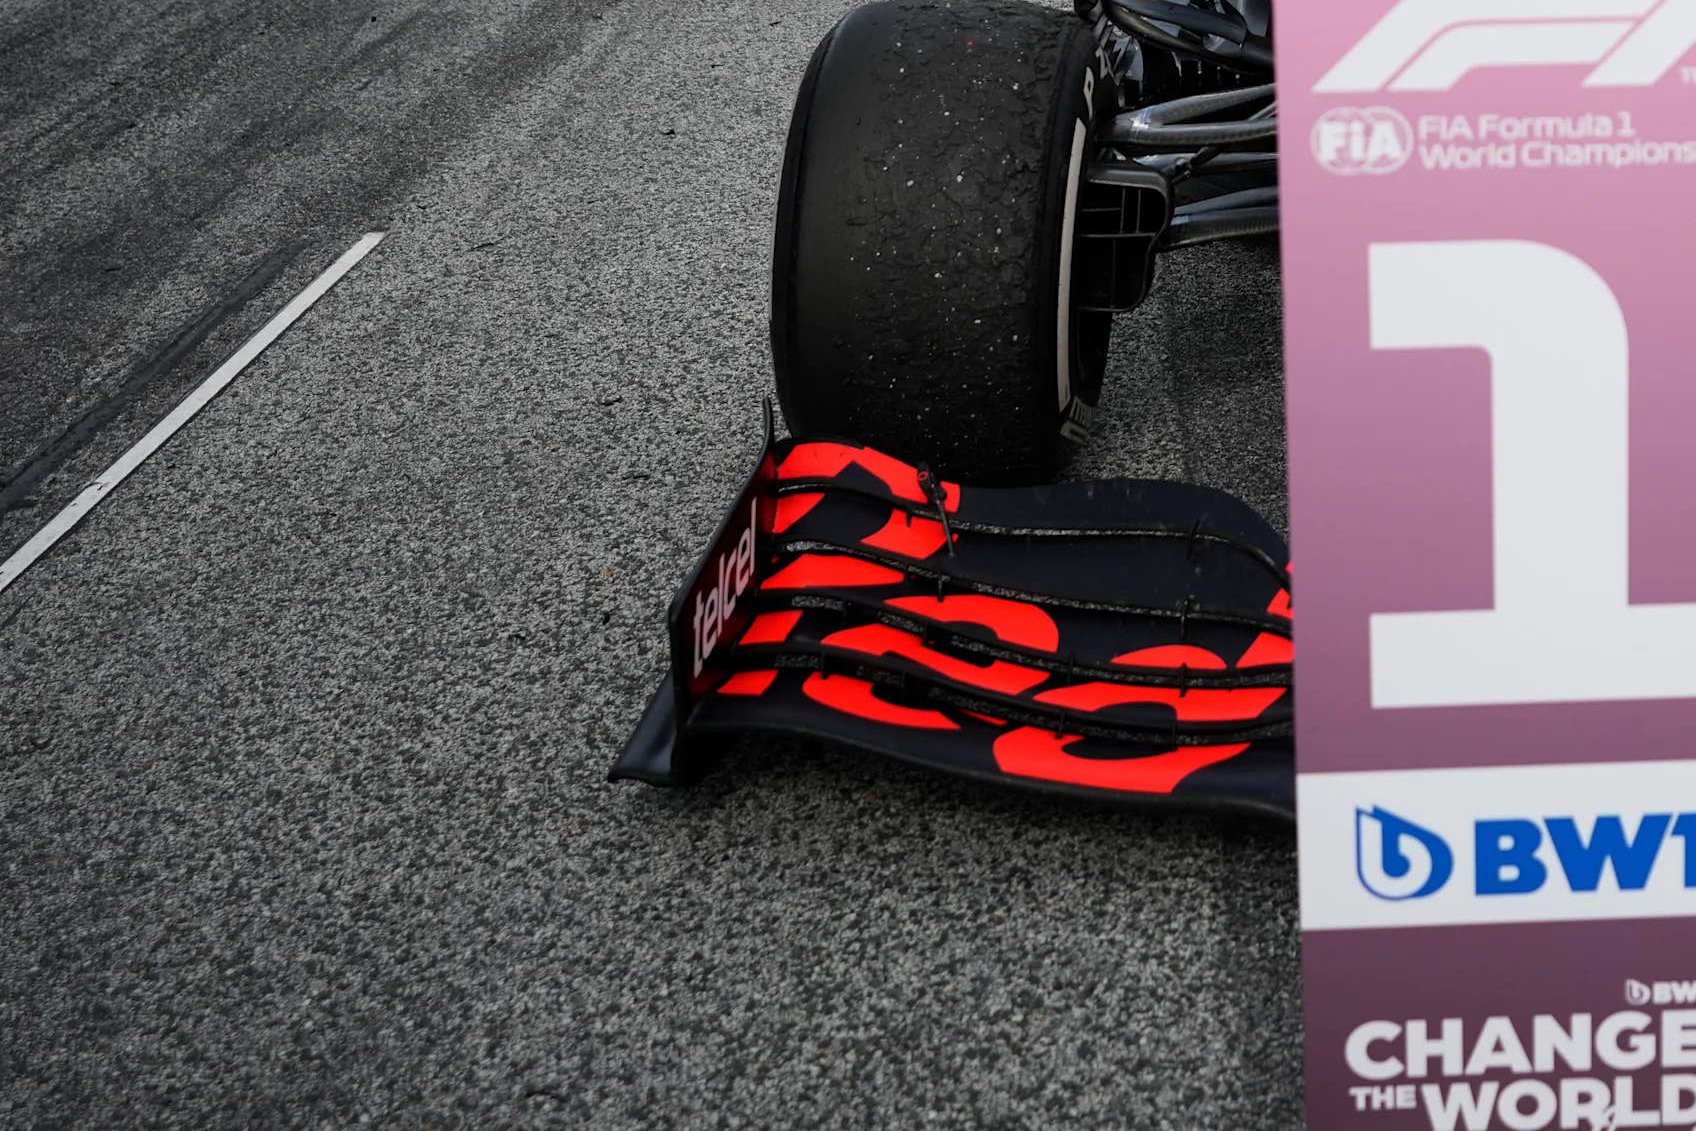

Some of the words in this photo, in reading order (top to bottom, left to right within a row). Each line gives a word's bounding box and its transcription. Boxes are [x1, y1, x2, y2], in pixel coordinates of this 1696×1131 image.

[1418, 114, 1474, 142] FIA
[1478, 112, 1614, 141] Formula
[1616, 110, 1637, 138] 1
[1418, 142, 1516, 171] World
[693, 496, 757, 679] telcel
[1349, 1084, 1417, 1111] THE
